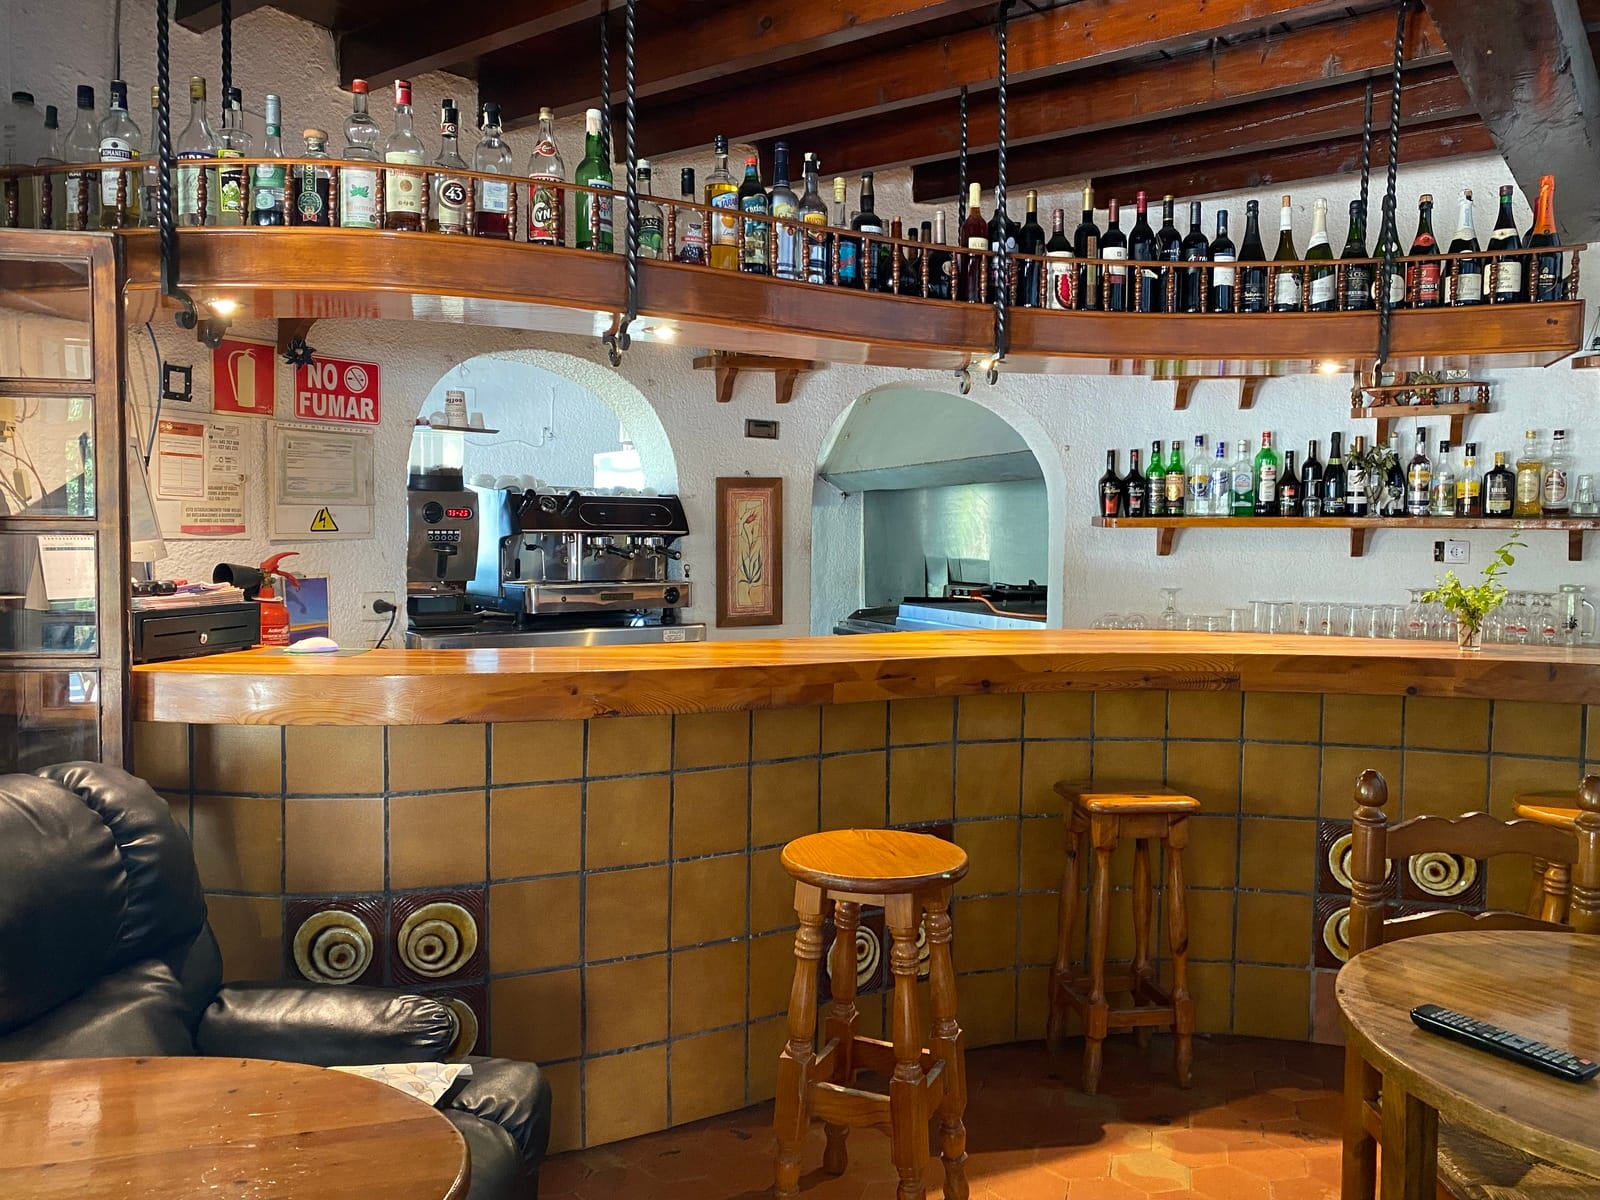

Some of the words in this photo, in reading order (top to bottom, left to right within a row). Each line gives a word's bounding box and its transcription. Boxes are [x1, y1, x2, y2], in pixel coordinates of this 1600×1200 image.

[445, 186, 463, 201] 43
[307, 362, 338, 391] NO
[299, 391, 375, 420] FUMAR
